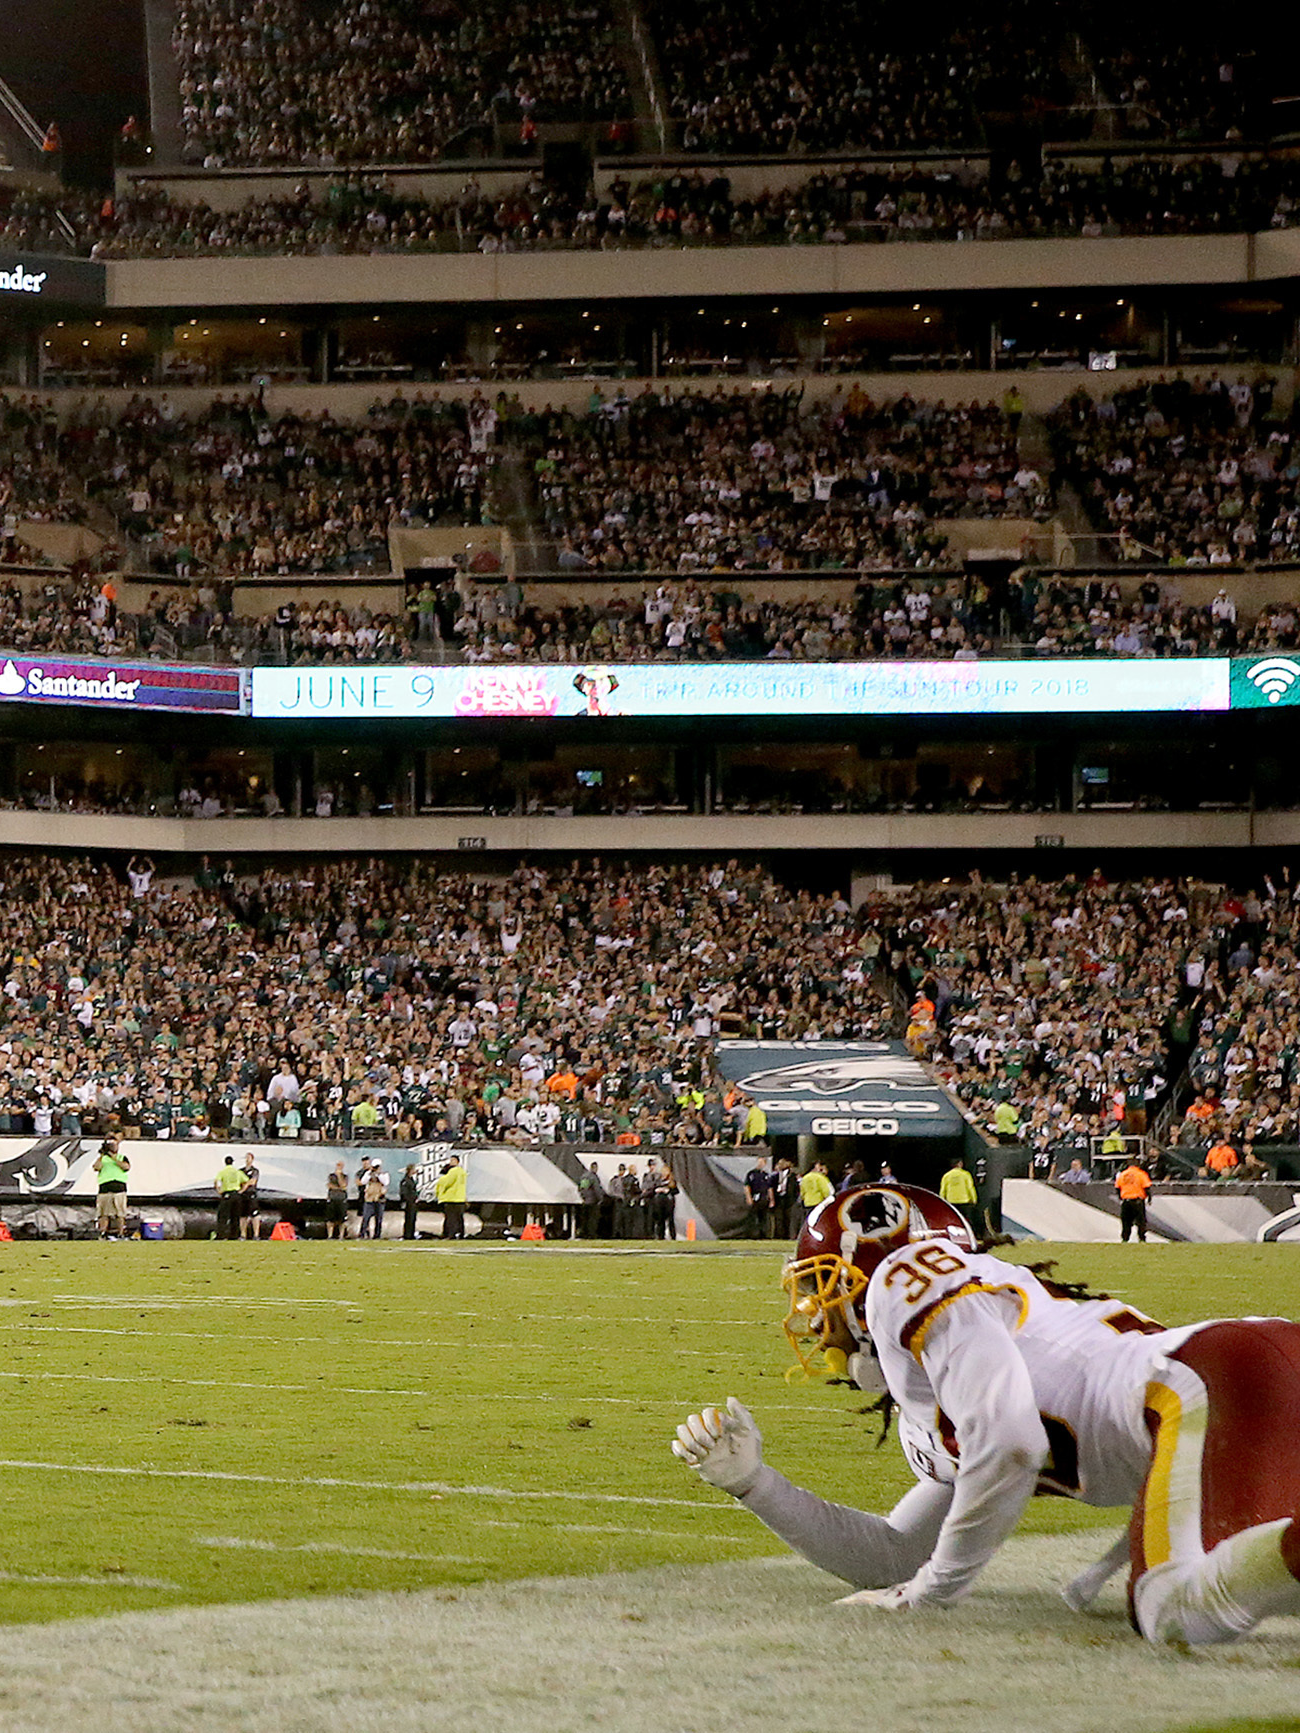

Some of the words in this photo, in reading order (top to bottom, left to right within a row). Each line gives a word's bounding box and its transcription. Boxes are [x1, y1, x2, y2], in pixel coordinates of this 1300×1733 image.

[27, 668, 140, 700] Santander
[470, 672, 541, 691] KENNY
[707, 682, 814, 699] AROUND
[951, 680, 1018, 697] TOUR
[1031, 679, 1089, 696] 2018
[280, 676, 393, 709] JUNE
[412, 675, 434, 708] 9
[456, 690, 556, 711] CHESNEY
[758, 1100, 940, 1112] GEICO
[812, 1118, 899, 1135] GEICO
[884, 1244, 966, 1306] 36
